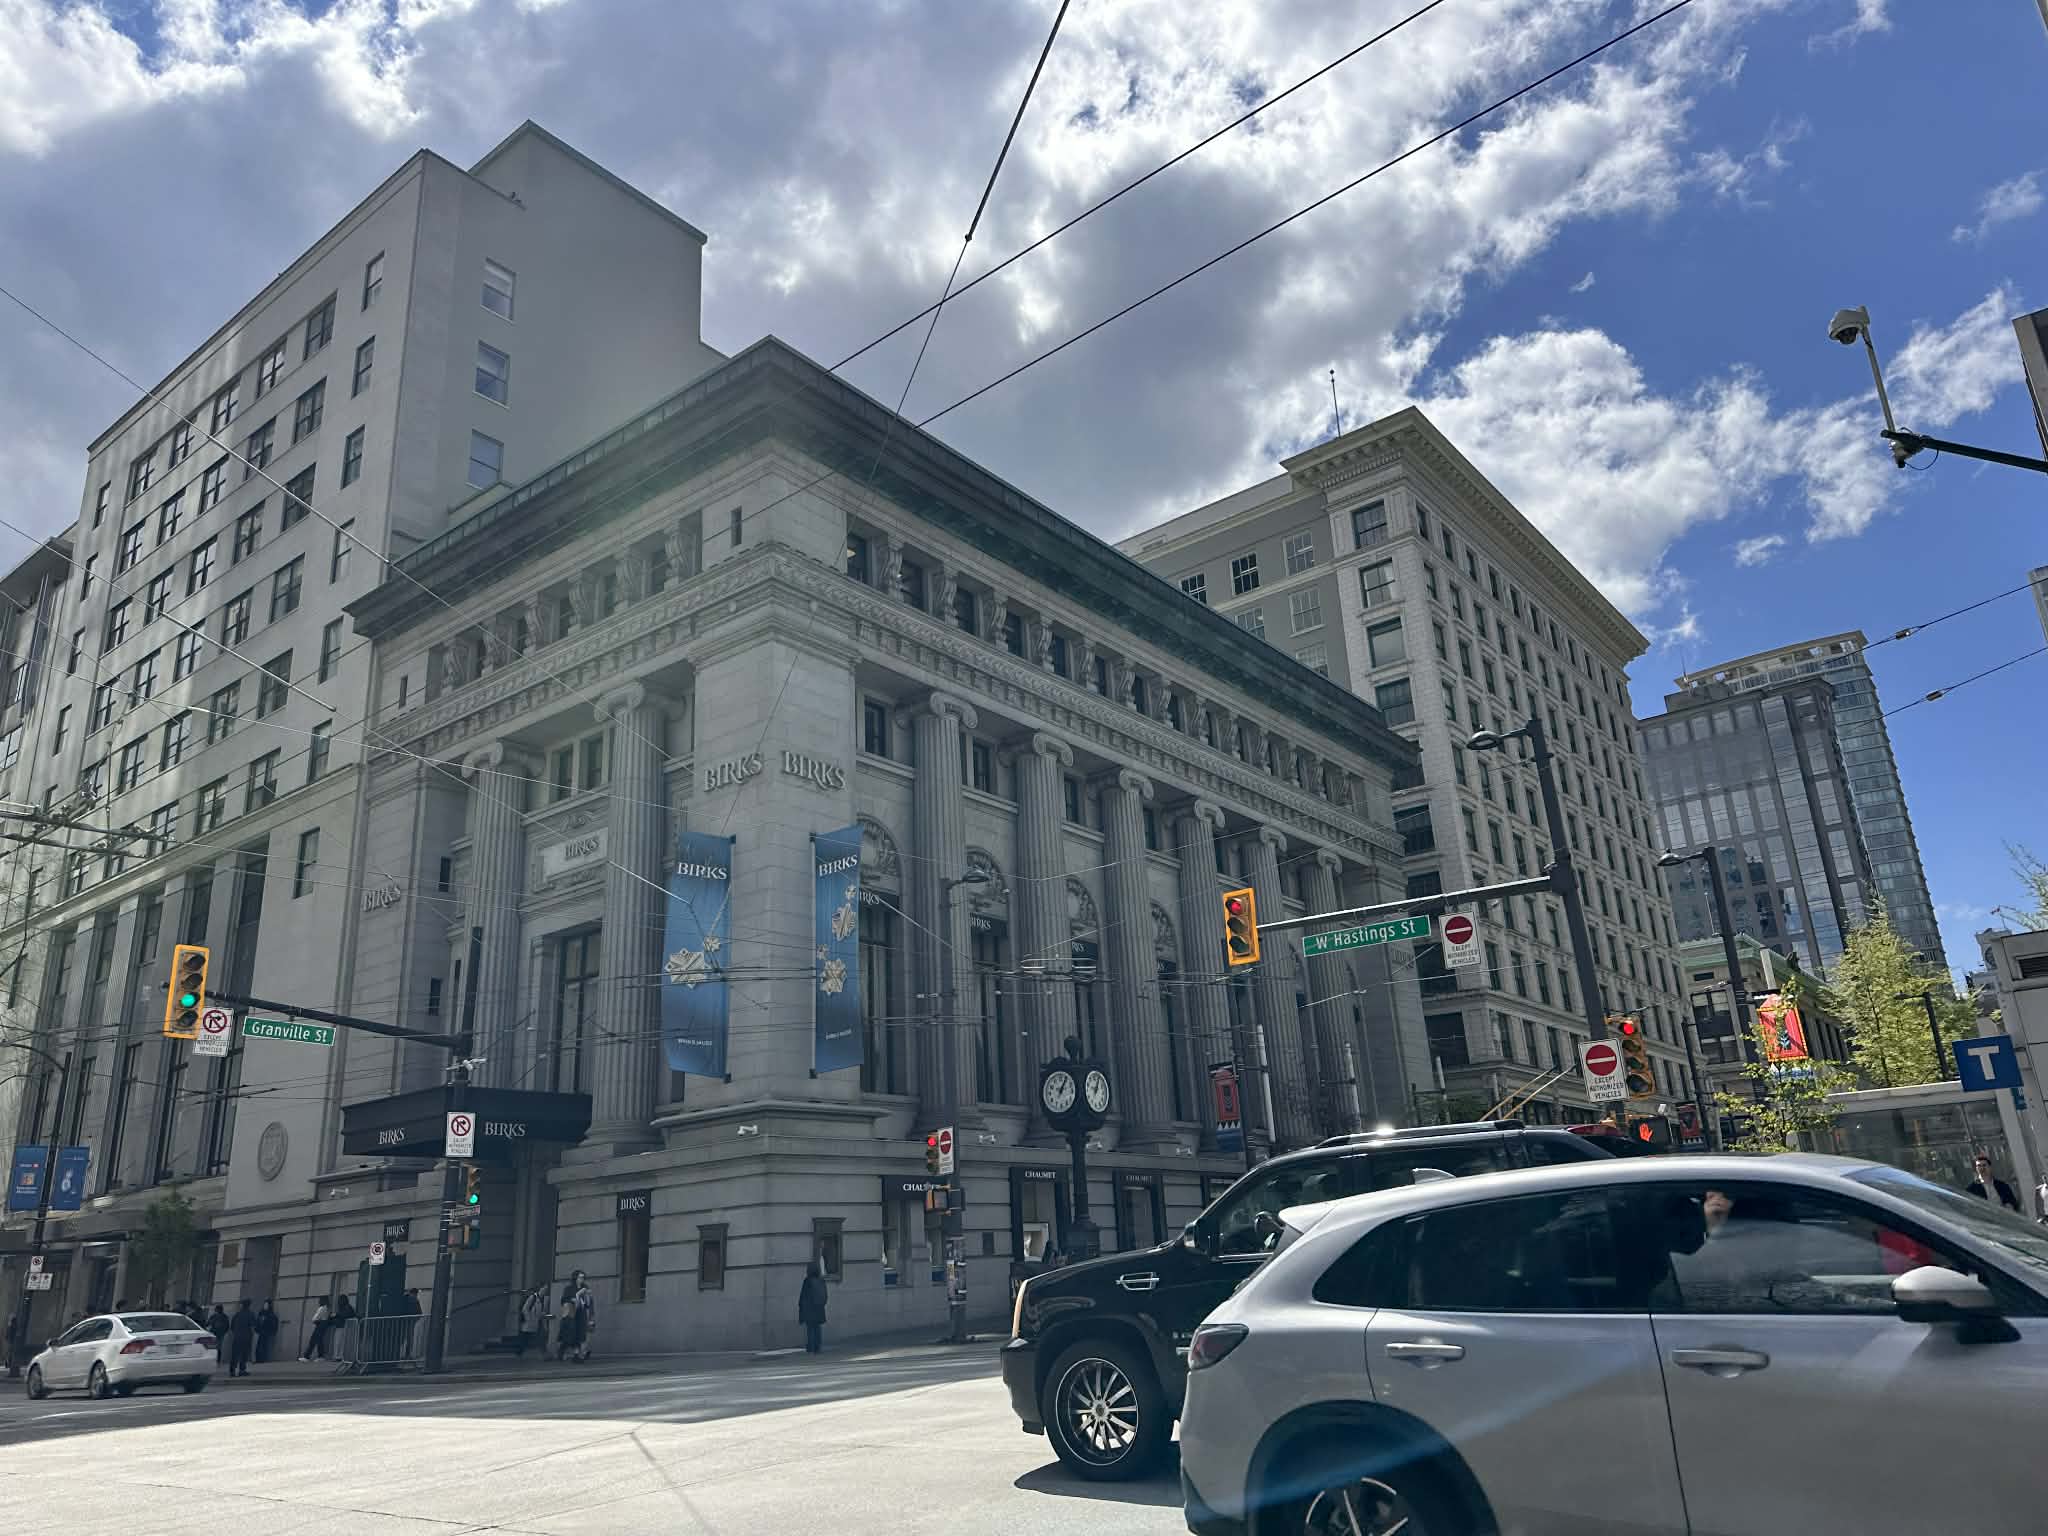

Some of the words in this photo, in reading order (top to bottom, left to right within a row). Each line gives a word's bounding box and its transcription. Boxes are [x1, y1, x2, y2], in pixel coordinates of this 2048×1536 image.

[704, 752, 763, 792] BIRKS
[783, 751, 848, 791] BIRKS
[565, 838, 599, 859] BIRKS
[677, 862, 728, 880] BIRKS
[818, 854, 858, 878] BIRKS
[859, 891, 880, 905] IRKS
[1315, 937, 1328, 950] W
[1334, 925, 1395, 947] Hastings
[1401, 921, 1416, 935] St
[251, 1021, 311, 1040] Granville
[314, 1029, 327, 1042] St
[1967, 1045, 2000, 1080] T
[1590, 1082, 1624, 1091] AUTHORIZED
[1595, 1090, 1621, 1099] VEHICLES
[378, 1127, 405, 1145] BIRKS
[484, 1121, 526, 1139] BIRKS
[620, 1196, 647, 1211] BIRKS
